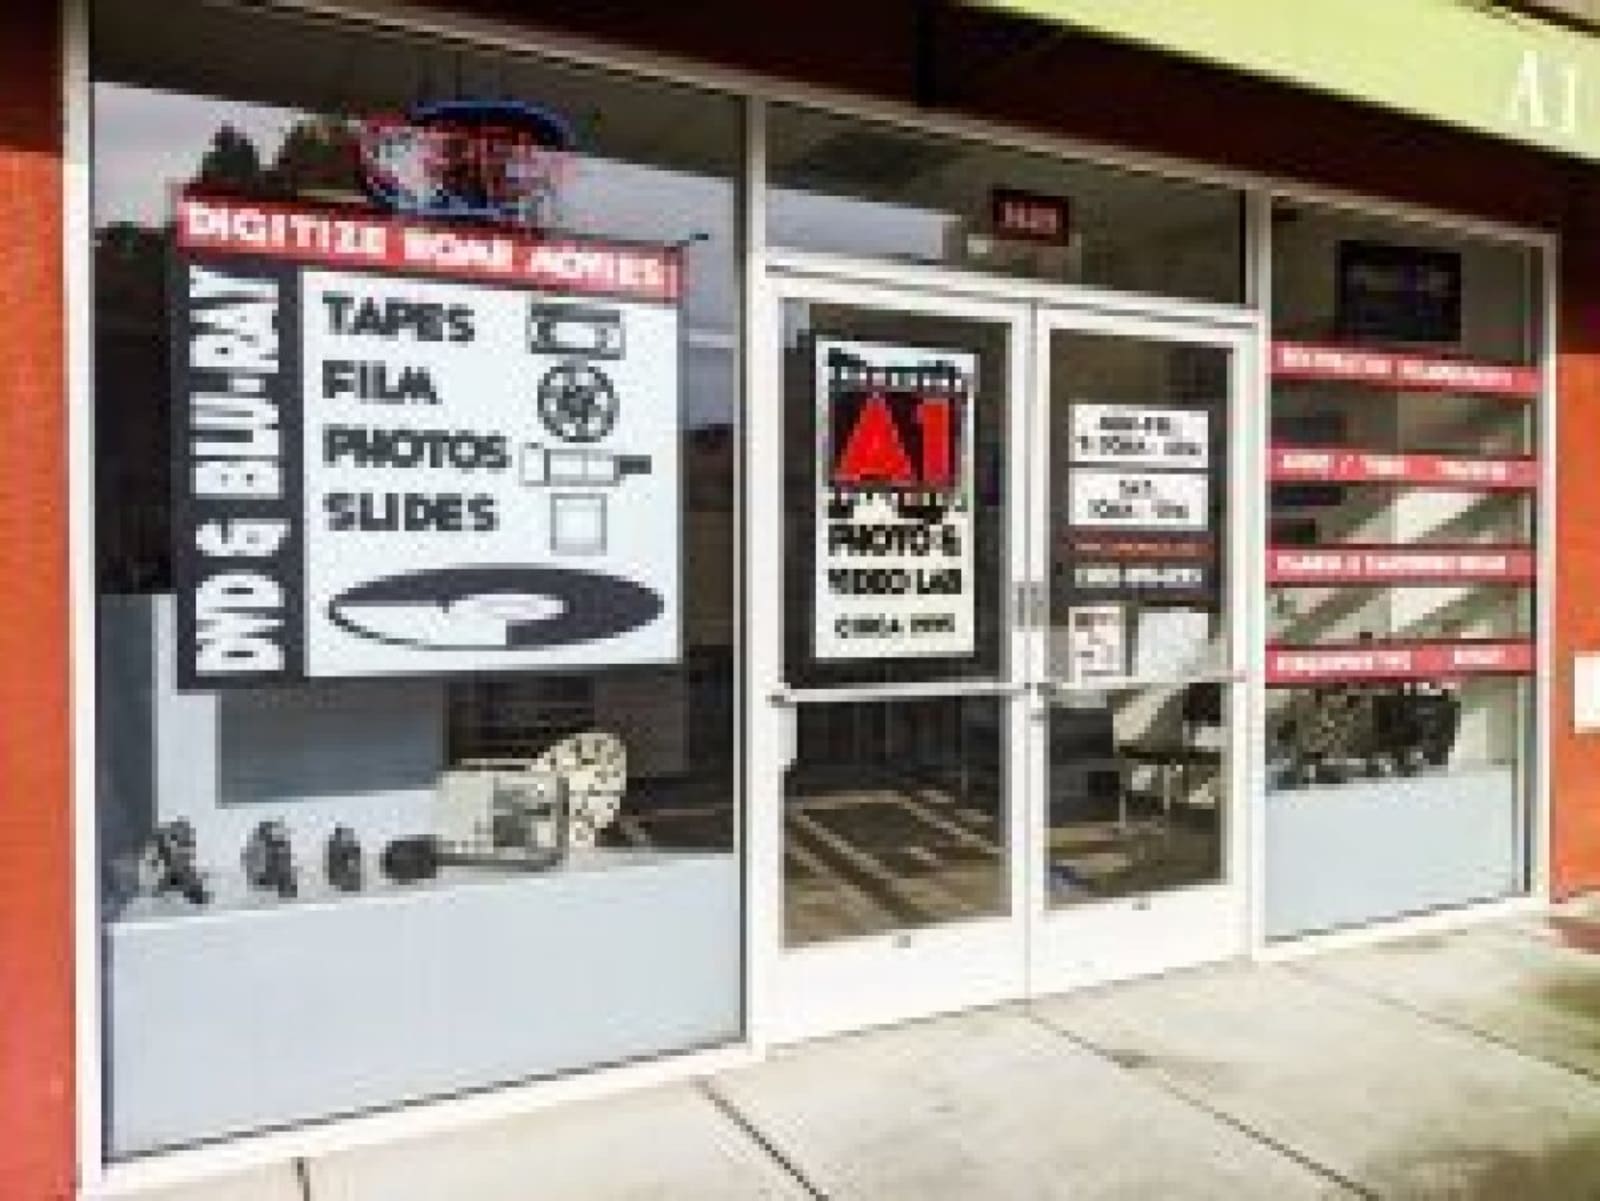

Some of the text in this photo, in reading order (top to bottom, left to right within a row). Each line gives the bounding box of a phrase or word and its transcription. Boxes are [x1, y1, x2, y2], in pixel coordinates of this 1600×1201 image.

[186, 202, 387, 257] DIGITIZE
[322, 292, 475, 341] TAPES
[322, 360, 440, 405] FILM
[322, 426, 512, 471] PHOTOS
[834, 393, 958, 487] A1
[322, 493, 497, 532] SLIDES
[827, 523, 931, 556] PHOTO
[194, 571, 286, 672] DVD
